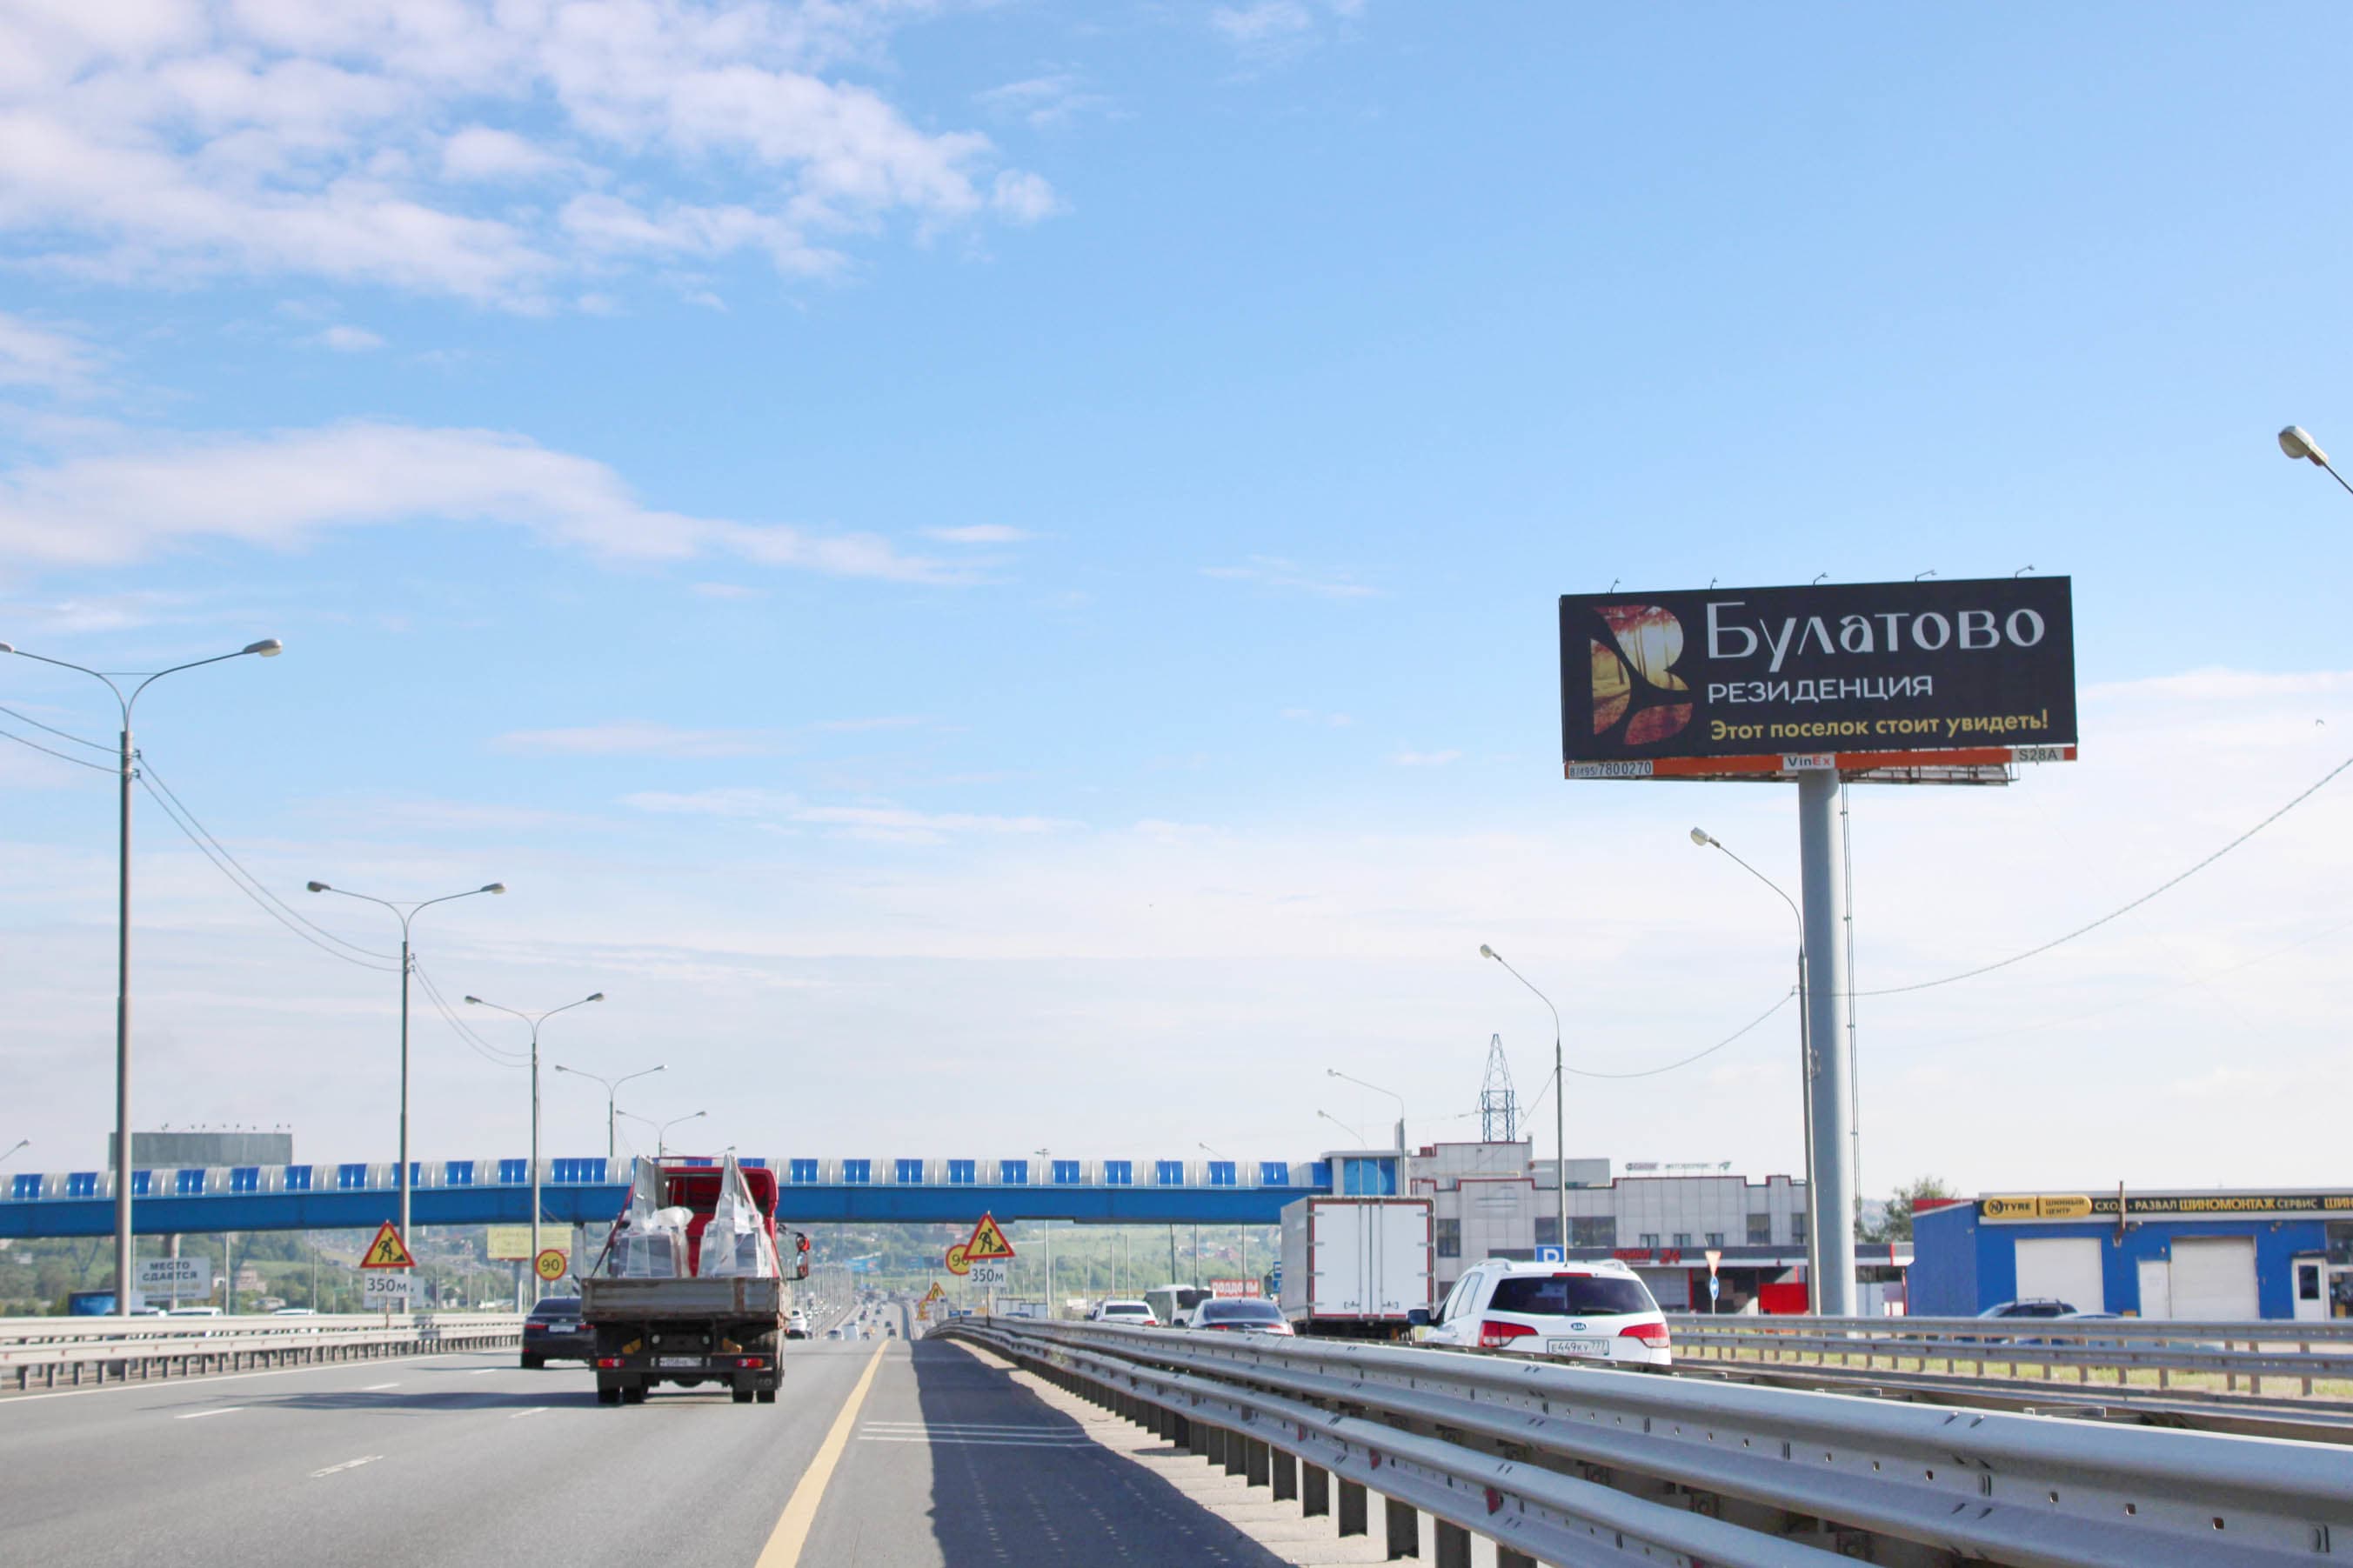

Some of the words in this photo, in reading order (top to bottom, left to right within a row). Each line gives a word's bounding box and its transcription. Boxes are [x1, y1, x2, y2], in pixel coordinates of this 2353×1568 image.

[1707, 602, 2045, 672] Булатово
[1708, 676, 1934, 704] РЕЗИДЕНЦИЯ
[1711, 720, 1763, 740] Этот
[1770, 718, 1868, 738] поселок
[1875, 718, 1940, 735] стоит
[1947, 709, 2049, 737] увидеть!
[1788, 755, 1831, 767] VinEx
[2019, 749, 2058, 761] S28A
[2095, 1201, 2121, 1211] СХО
[2180, 1198, 2276, 1211] ШИНОМОНТАЖ
[2276, 1198, 2318, 1210] СЕРВИС
[150, 1261, 190, 1270] МЕСТО
[542, 1258, 559, 1271] 90
